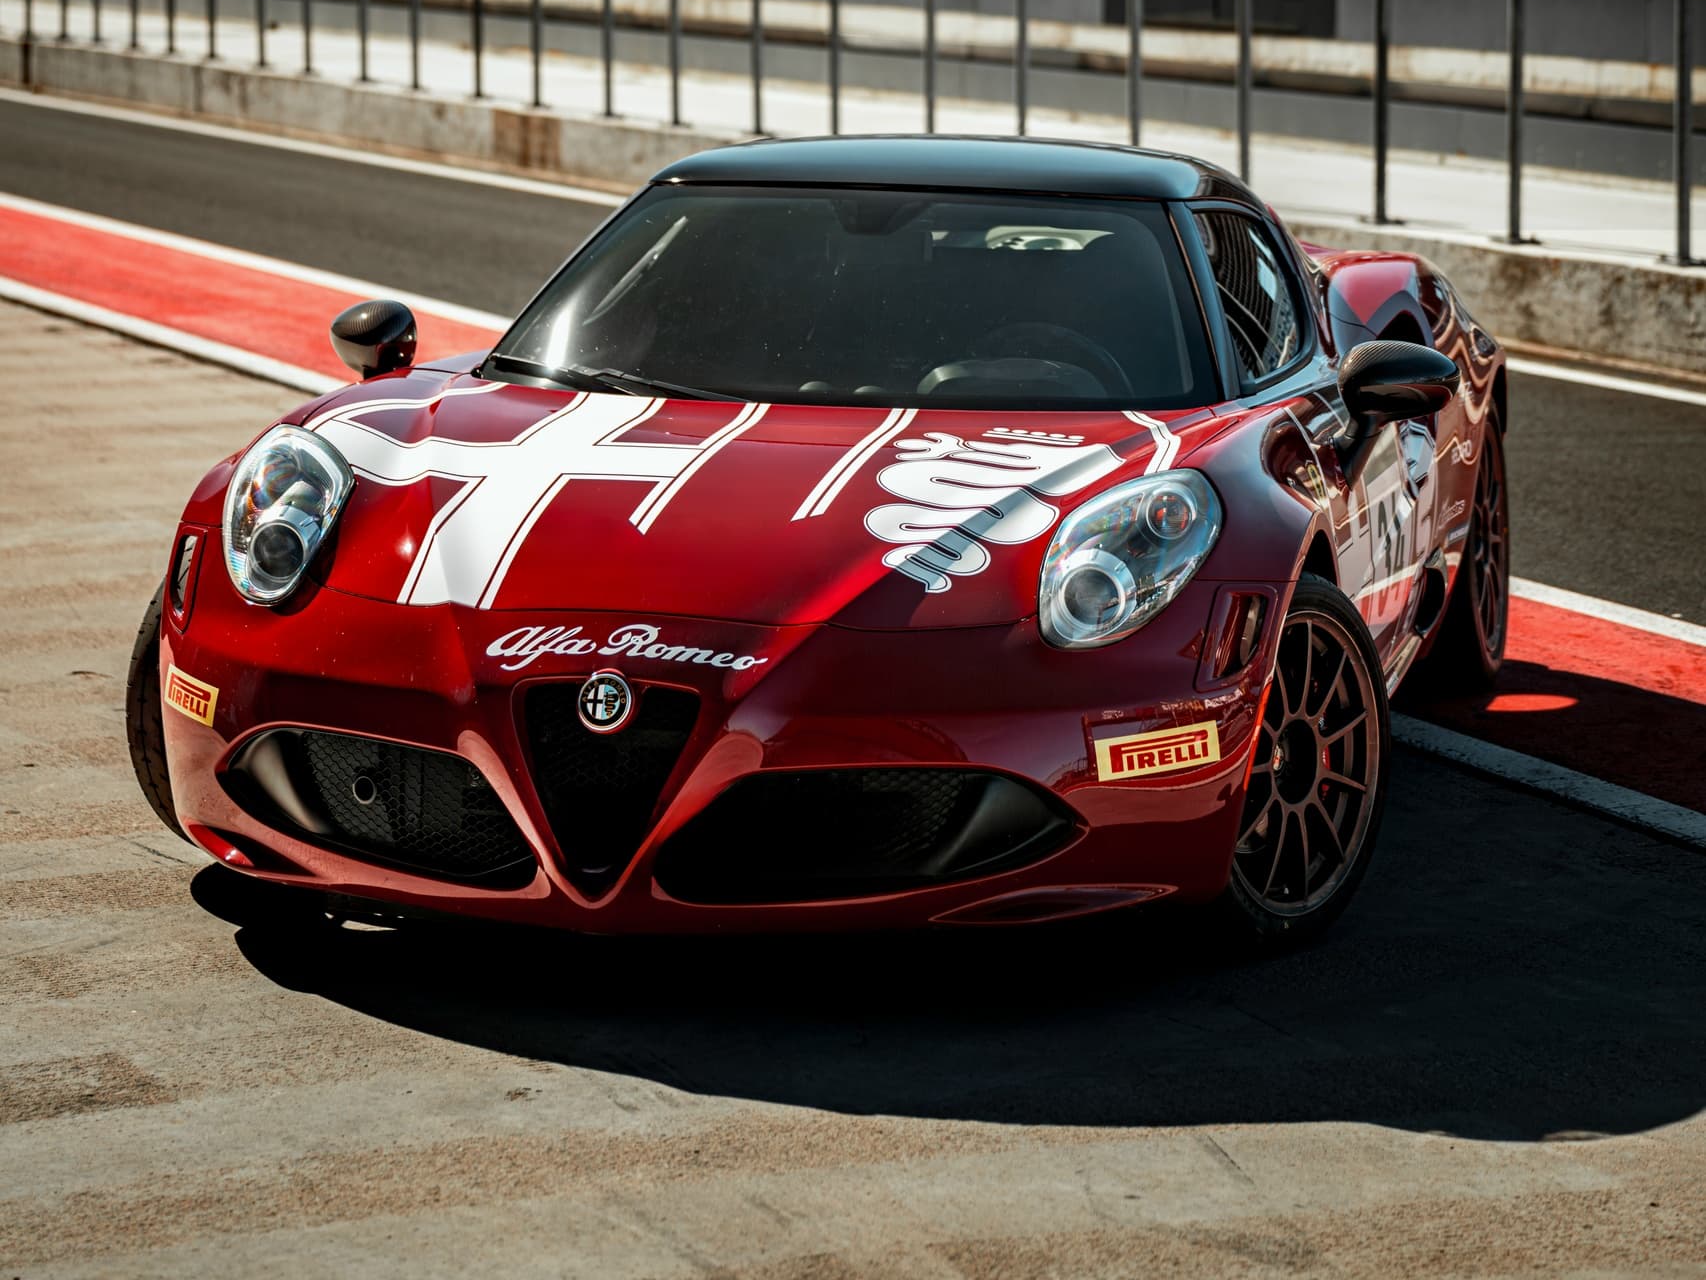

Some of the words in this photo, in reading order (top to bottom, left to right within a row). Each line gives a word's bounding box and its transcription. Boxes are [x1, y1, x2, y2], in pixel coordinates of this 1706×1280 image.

[486, 626, 597, 670] Alfa
[598, 624, 768, 670] Romeo
[168, 672, 211, 718] PIRELLI
[1109, 729, 1208, 774] PIRELLI
